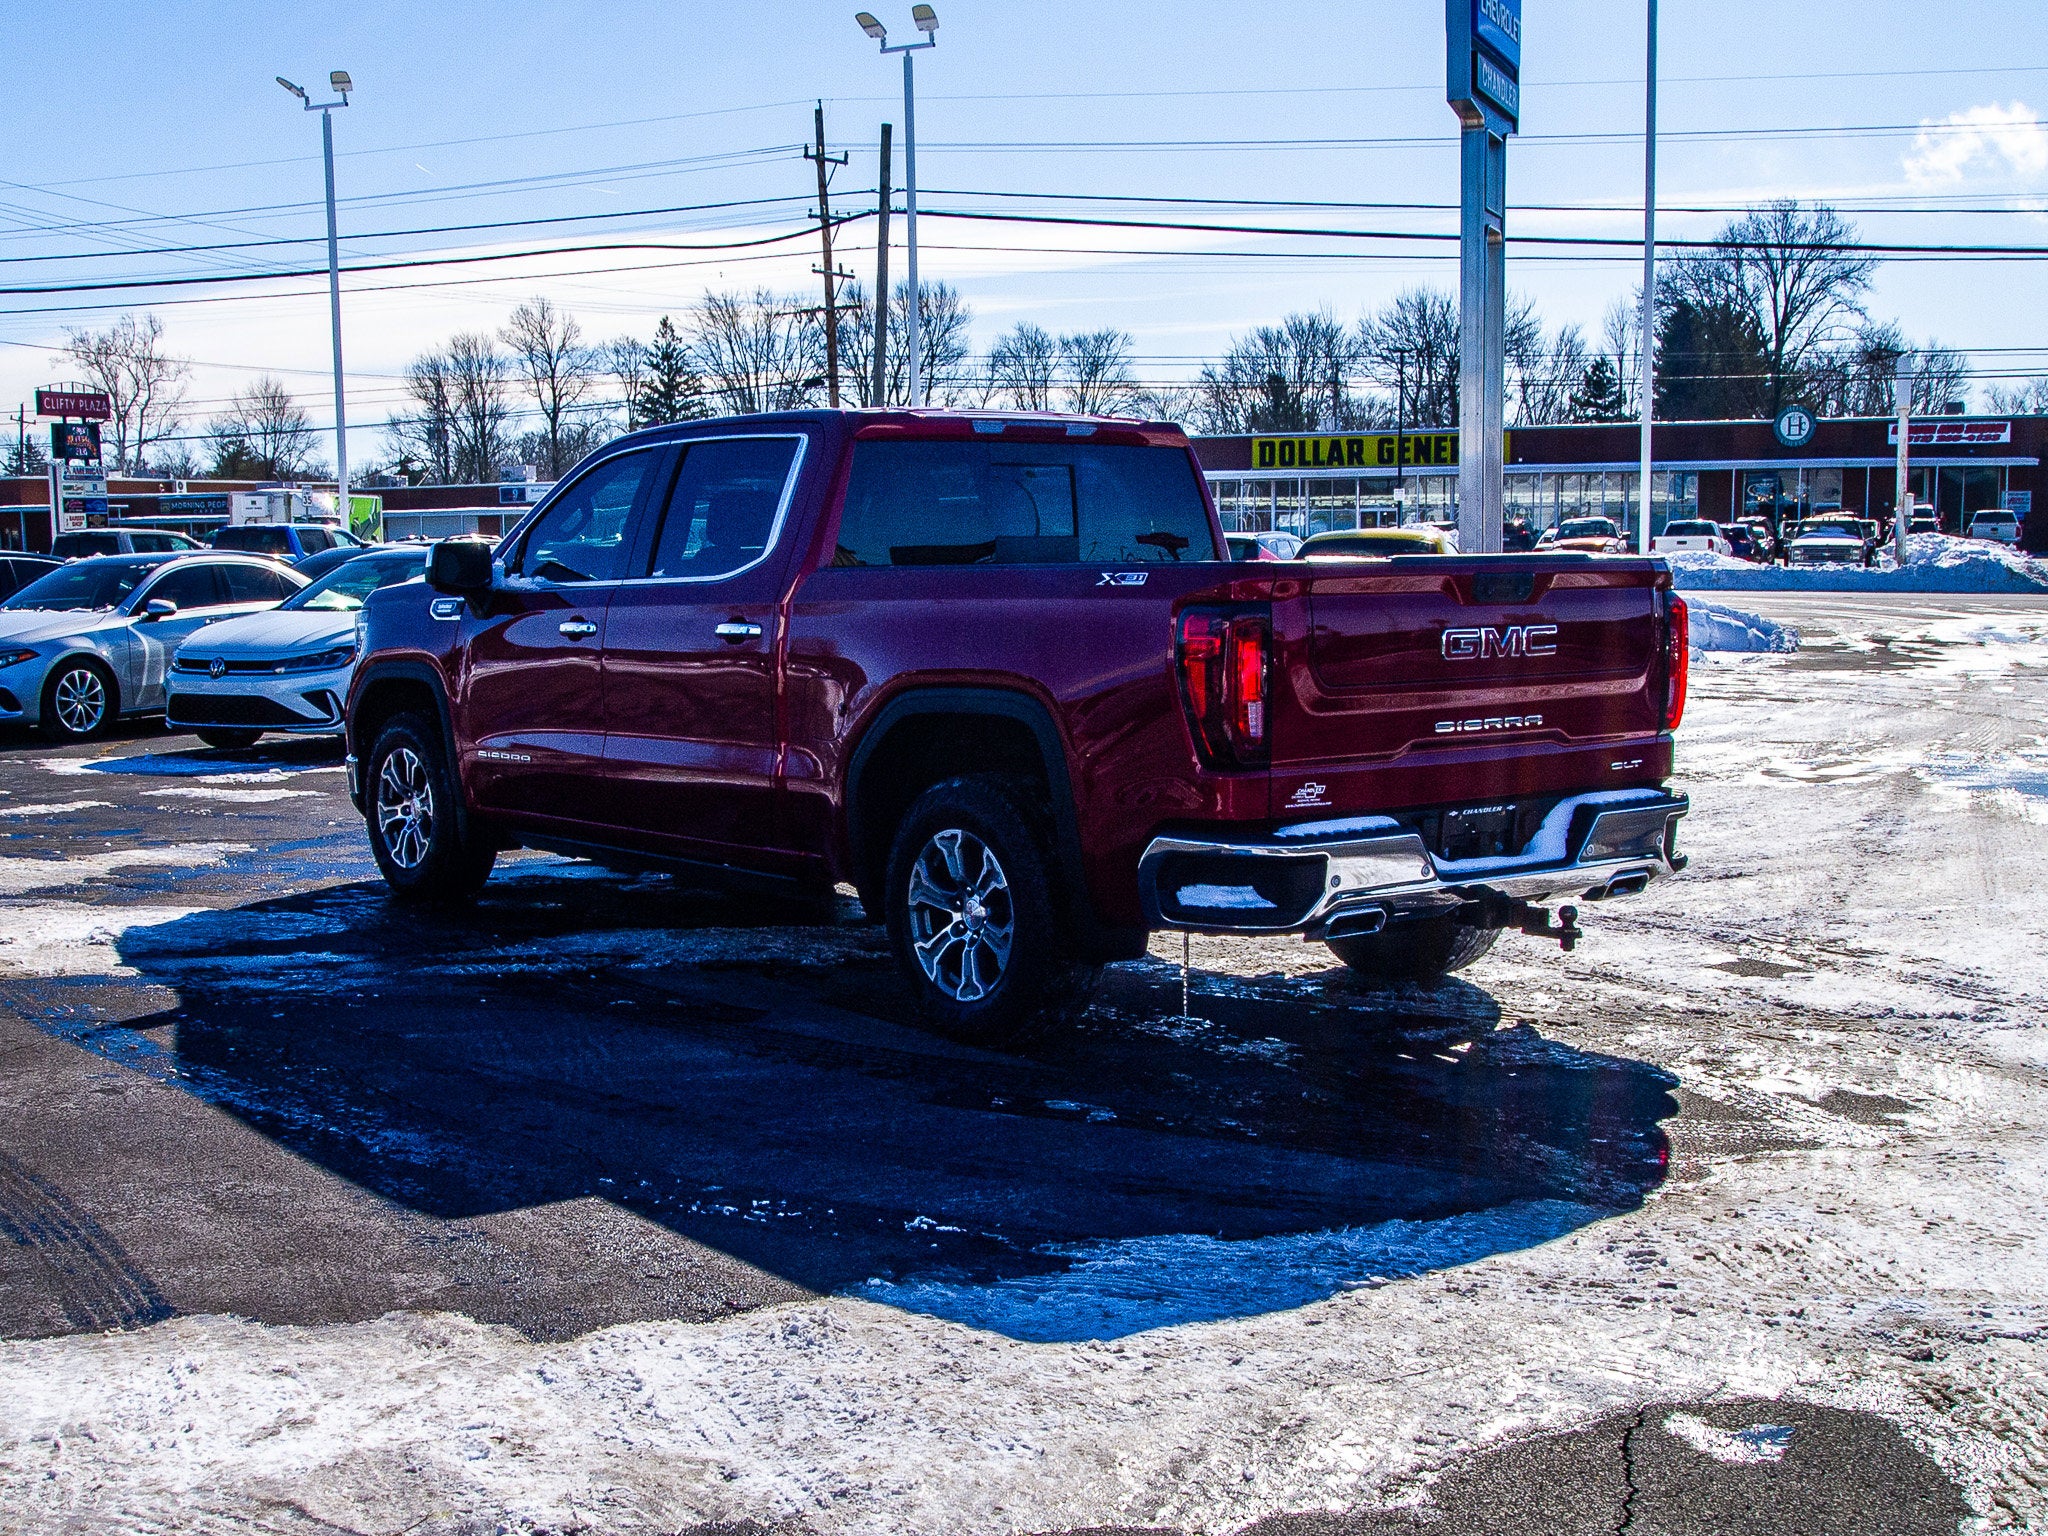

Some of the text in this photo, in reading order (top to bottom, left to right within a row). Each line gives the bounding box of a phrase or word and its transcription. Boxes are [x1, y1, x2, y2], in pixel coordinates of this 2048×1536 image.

[1481, 0, 1520, 44] CHEVROLE
[1482, 62, 1517, 111] CHANDLER
[43, 397, 108, 412] CLIFTY PLAZA
[1258, 435, 1459, 467] DOLLAR GENE
[171, 500, 227, 509] MORNING PEOP
[303, 495, 312, 505] 35
[1441, 624, 1558, 660] GMC
[1434, 714, 1543, 733] SIERRA
[477, 750, 531, 762] SIERRA
[1462, 805, 1503, 815] CHANDLER
